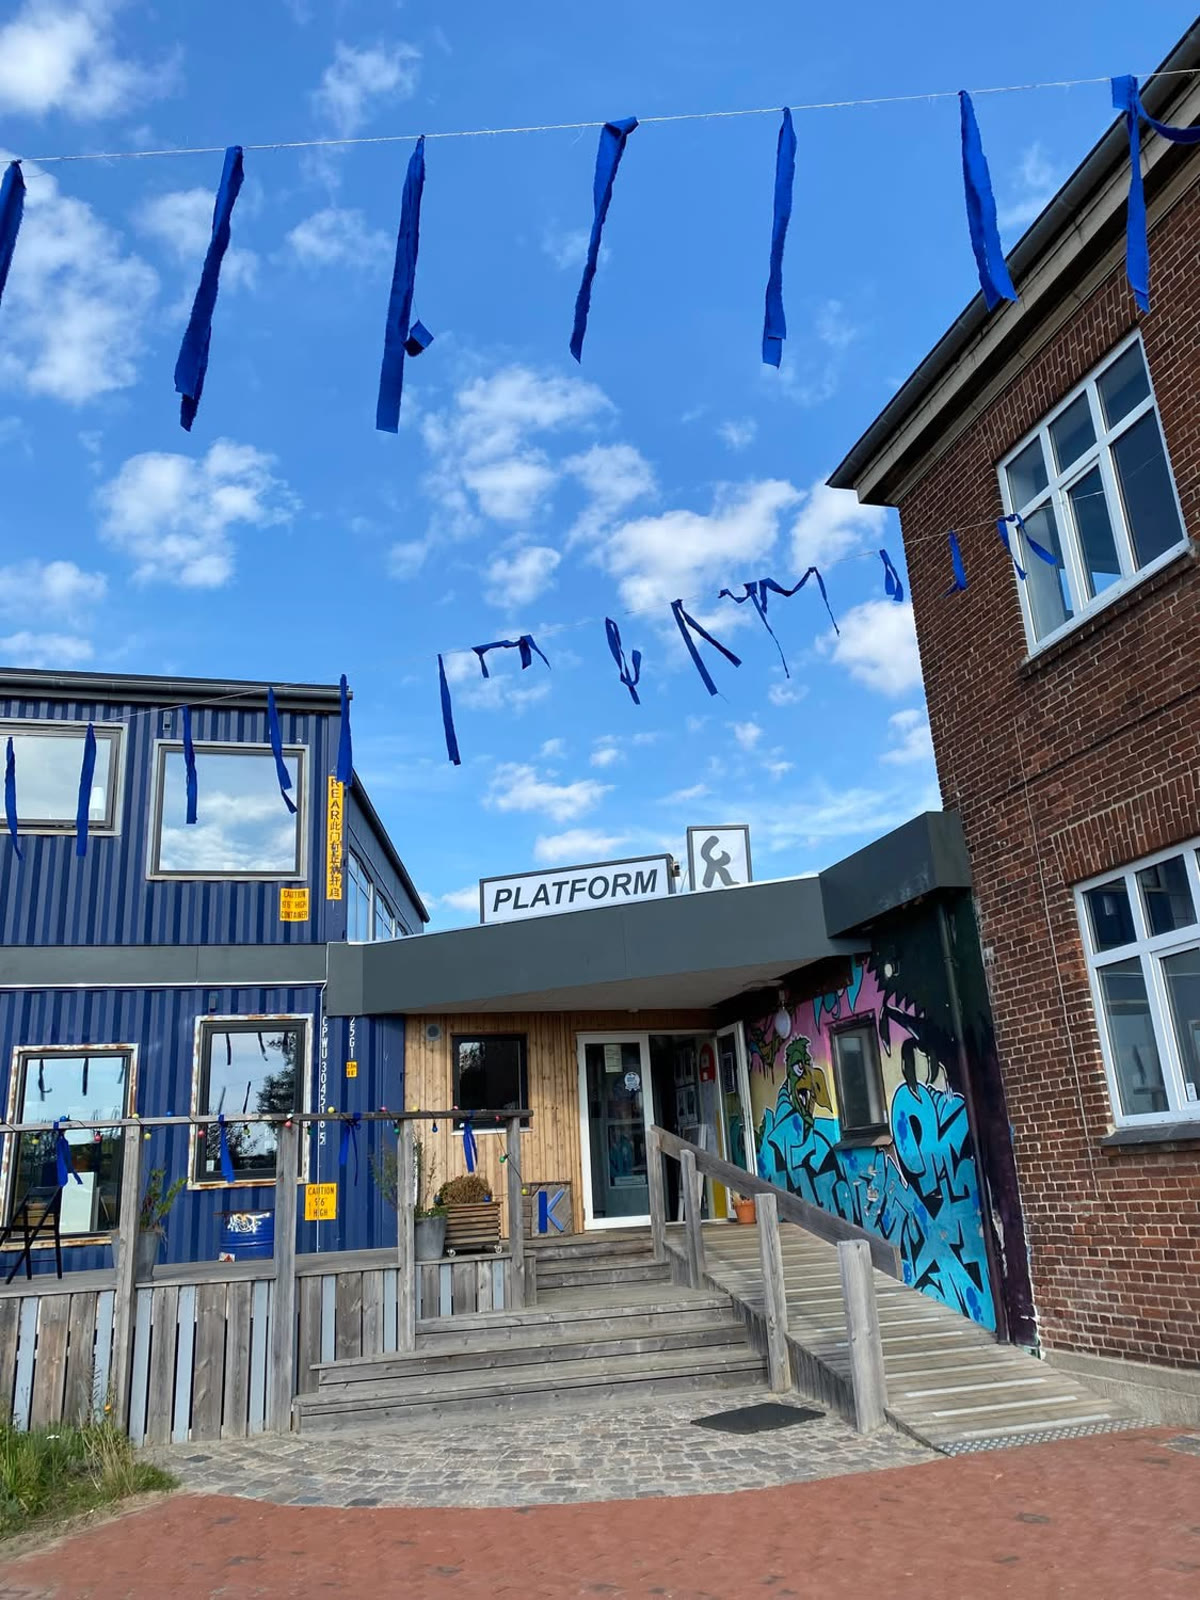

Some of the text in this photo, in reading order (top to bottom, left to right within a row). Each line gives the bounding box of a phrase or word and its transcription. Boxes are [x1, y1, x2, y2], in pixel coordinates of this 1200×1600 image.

[330, 778, 341, 820] REAR
[283, 890, 306, 899] CAUTION
[492, 868, 658, 912] PLATFORM
[294, 900, 307, 909] HIGH
[280, 910, 308, 920] CONTAINER
[307, 1186, 334, 1196] CAUTION
[313, 1208, 328, 1218] HIGH
[537, 1188, 565, 1234] K
